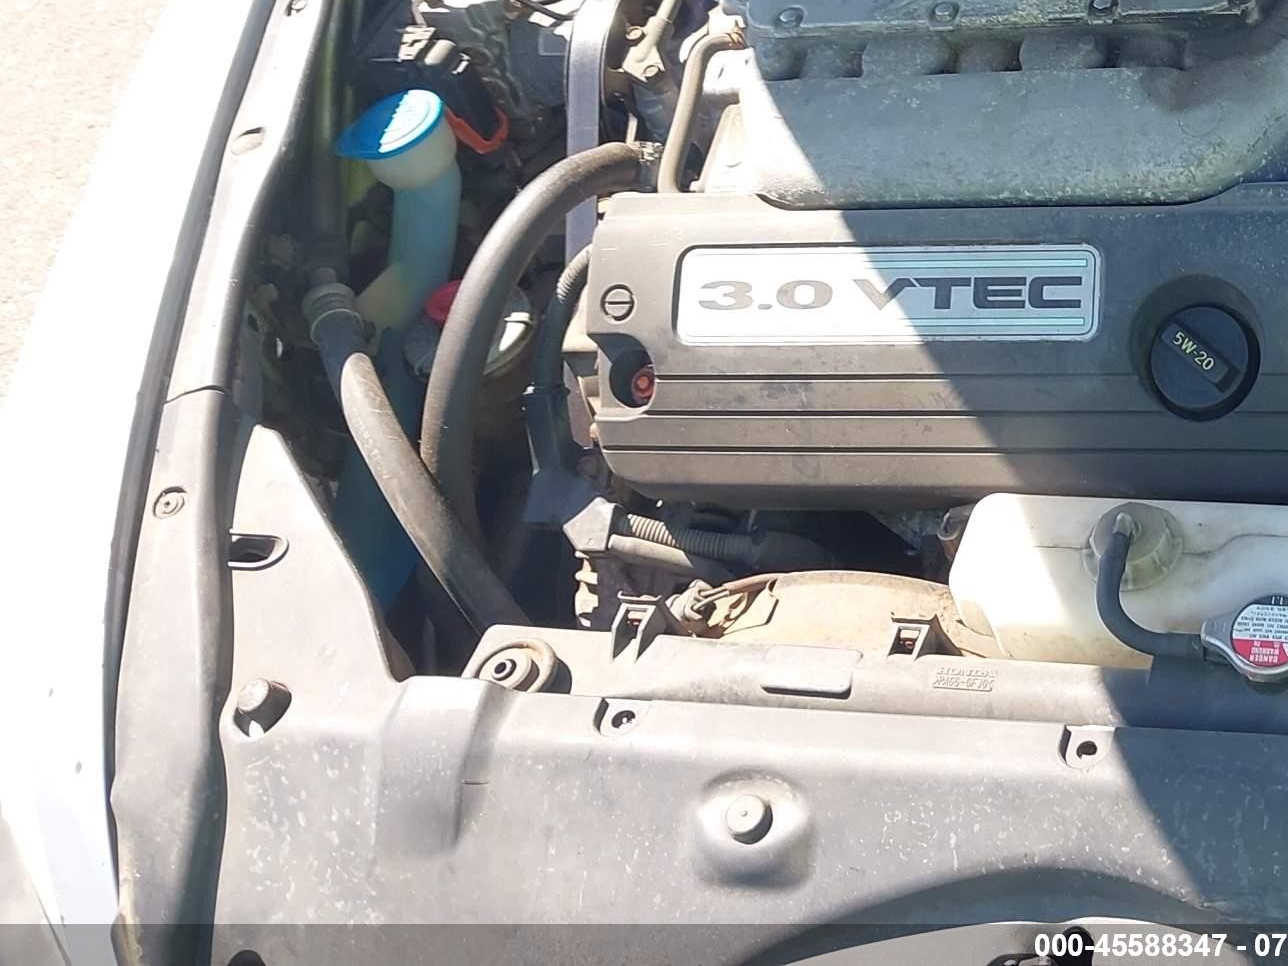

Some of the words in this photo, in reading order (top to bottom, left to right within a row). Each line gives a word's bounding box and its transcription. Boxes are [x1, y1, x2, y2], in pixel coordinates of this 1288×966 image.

[698, 280, 834, 311] 3.0
[852, 276, 1083, 311] VTEC
[1171, 331, 1215, 371] 5W-20
[1249, 654, 1279, 663] DANGER
[1251, 647, 1280, 655] WARNING
